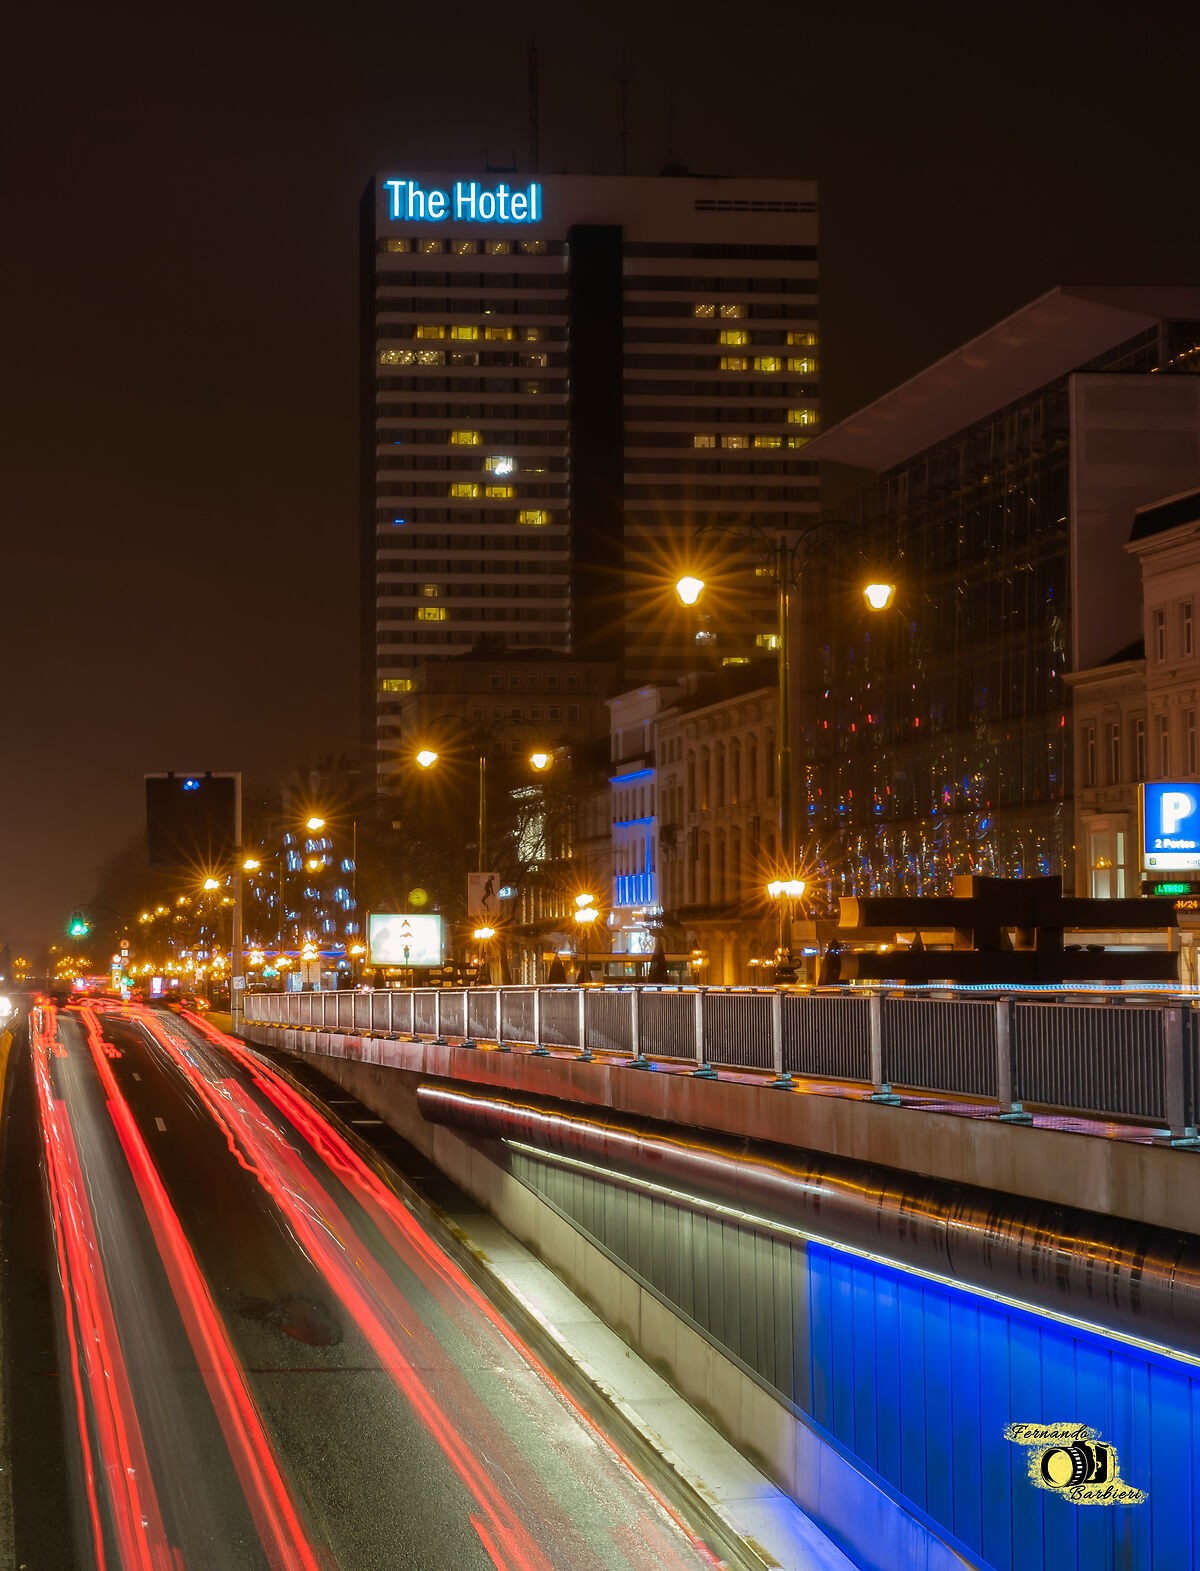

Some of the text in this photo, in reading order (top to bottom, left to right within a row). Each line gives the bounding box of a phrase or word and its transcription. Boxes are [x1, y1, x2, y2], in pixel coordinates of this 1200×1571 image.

[384, 180, 539, 221] The Hotel
[1161, 792, 1195, 834] P
[1155, 838, 1162, 849] 2
